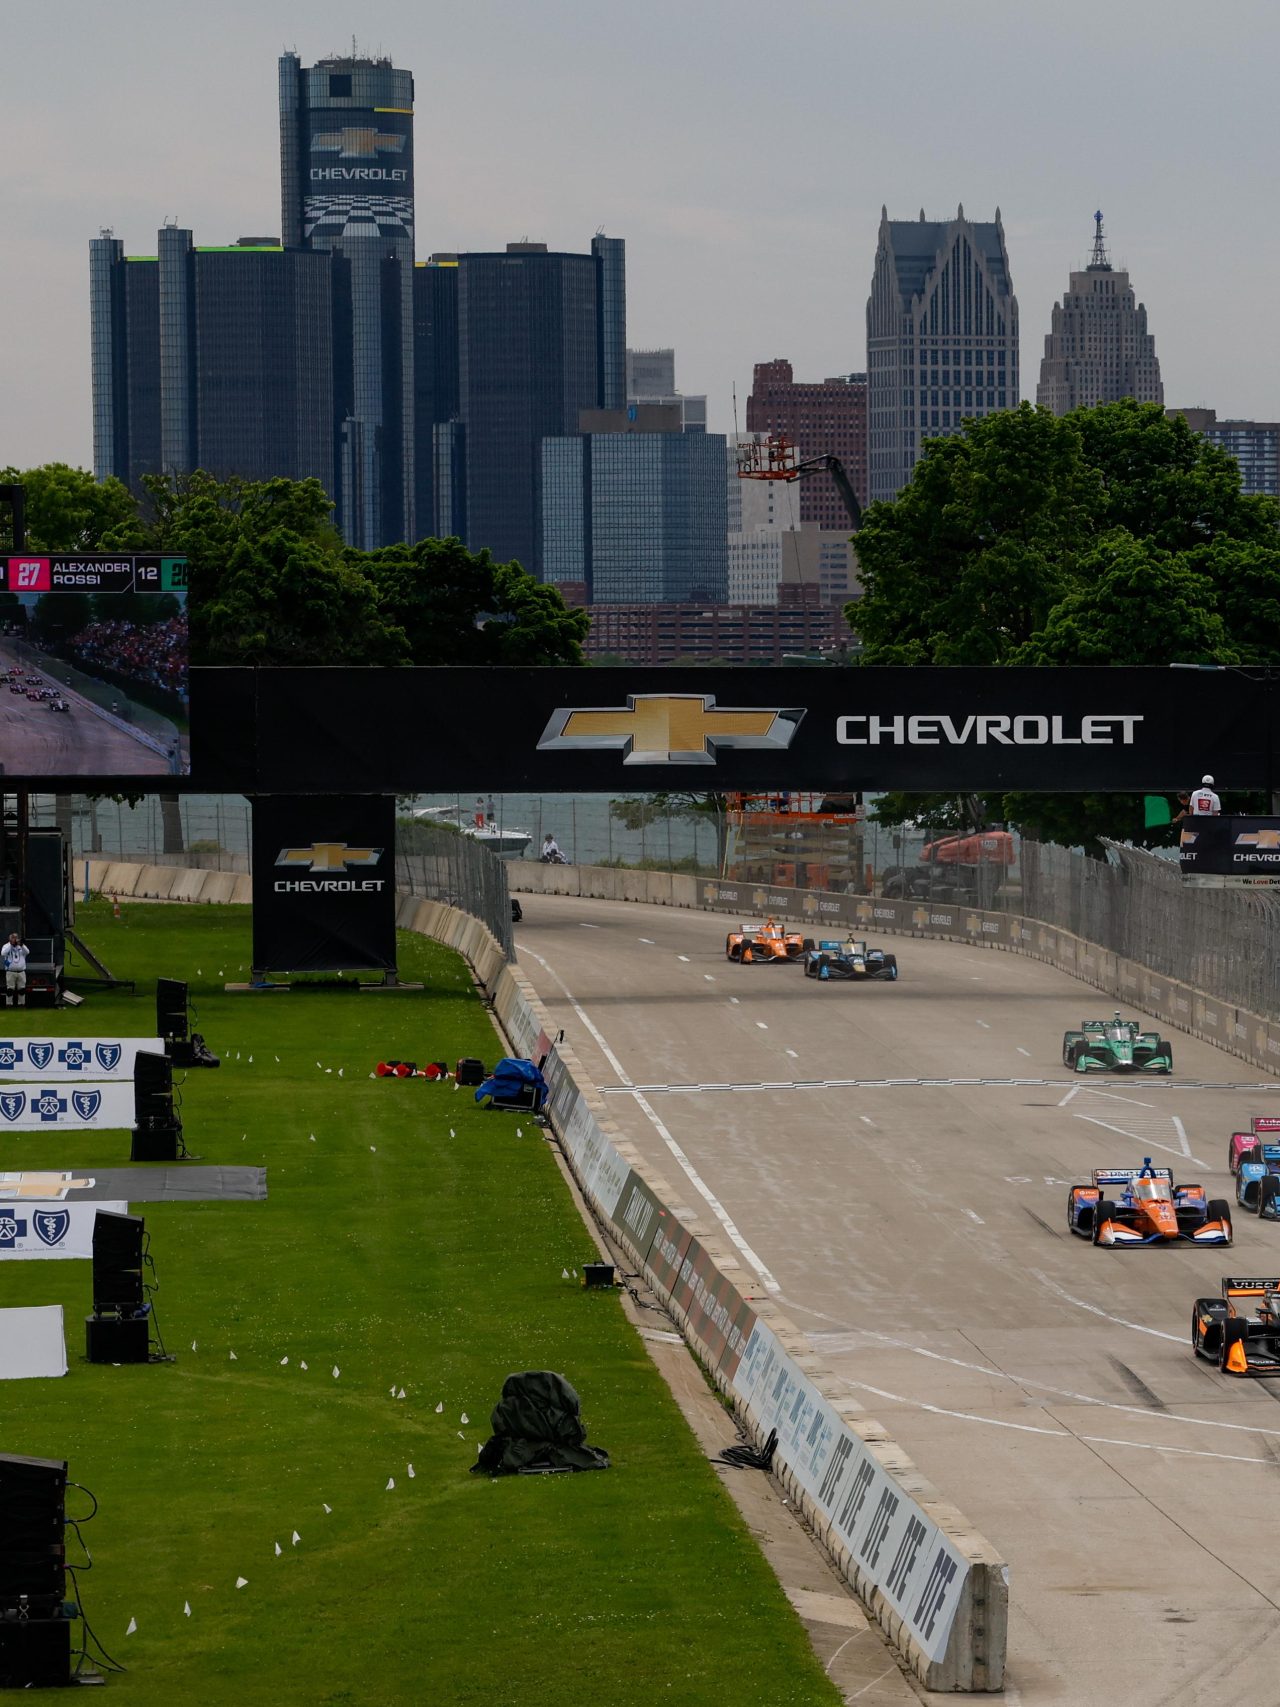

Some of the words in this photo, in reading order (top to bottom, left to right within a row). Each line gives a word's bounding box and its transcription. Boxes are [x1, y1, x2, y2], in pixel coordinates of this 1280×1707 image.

[310, 168, 408, 180] CHEVROLET
[18, 563, 40, 586] 27
[53, 563, 130, 573] ALEXANDER
[53, 575, 100, 584] ROSSI
[138, 567, 158, 580] 12
[836, 716, 1144, 744] CHEVROLET
[274, 880, 385, 892] CHEVROLET
[819, 1434, 854, 1508] DTE
[839, 1459, 875, 1538] DTE
[860, 1487, 900, 1570] DTE
[886, 1514, 926, 1602] DTE
[912, 1548, 957, 1640] DTE
